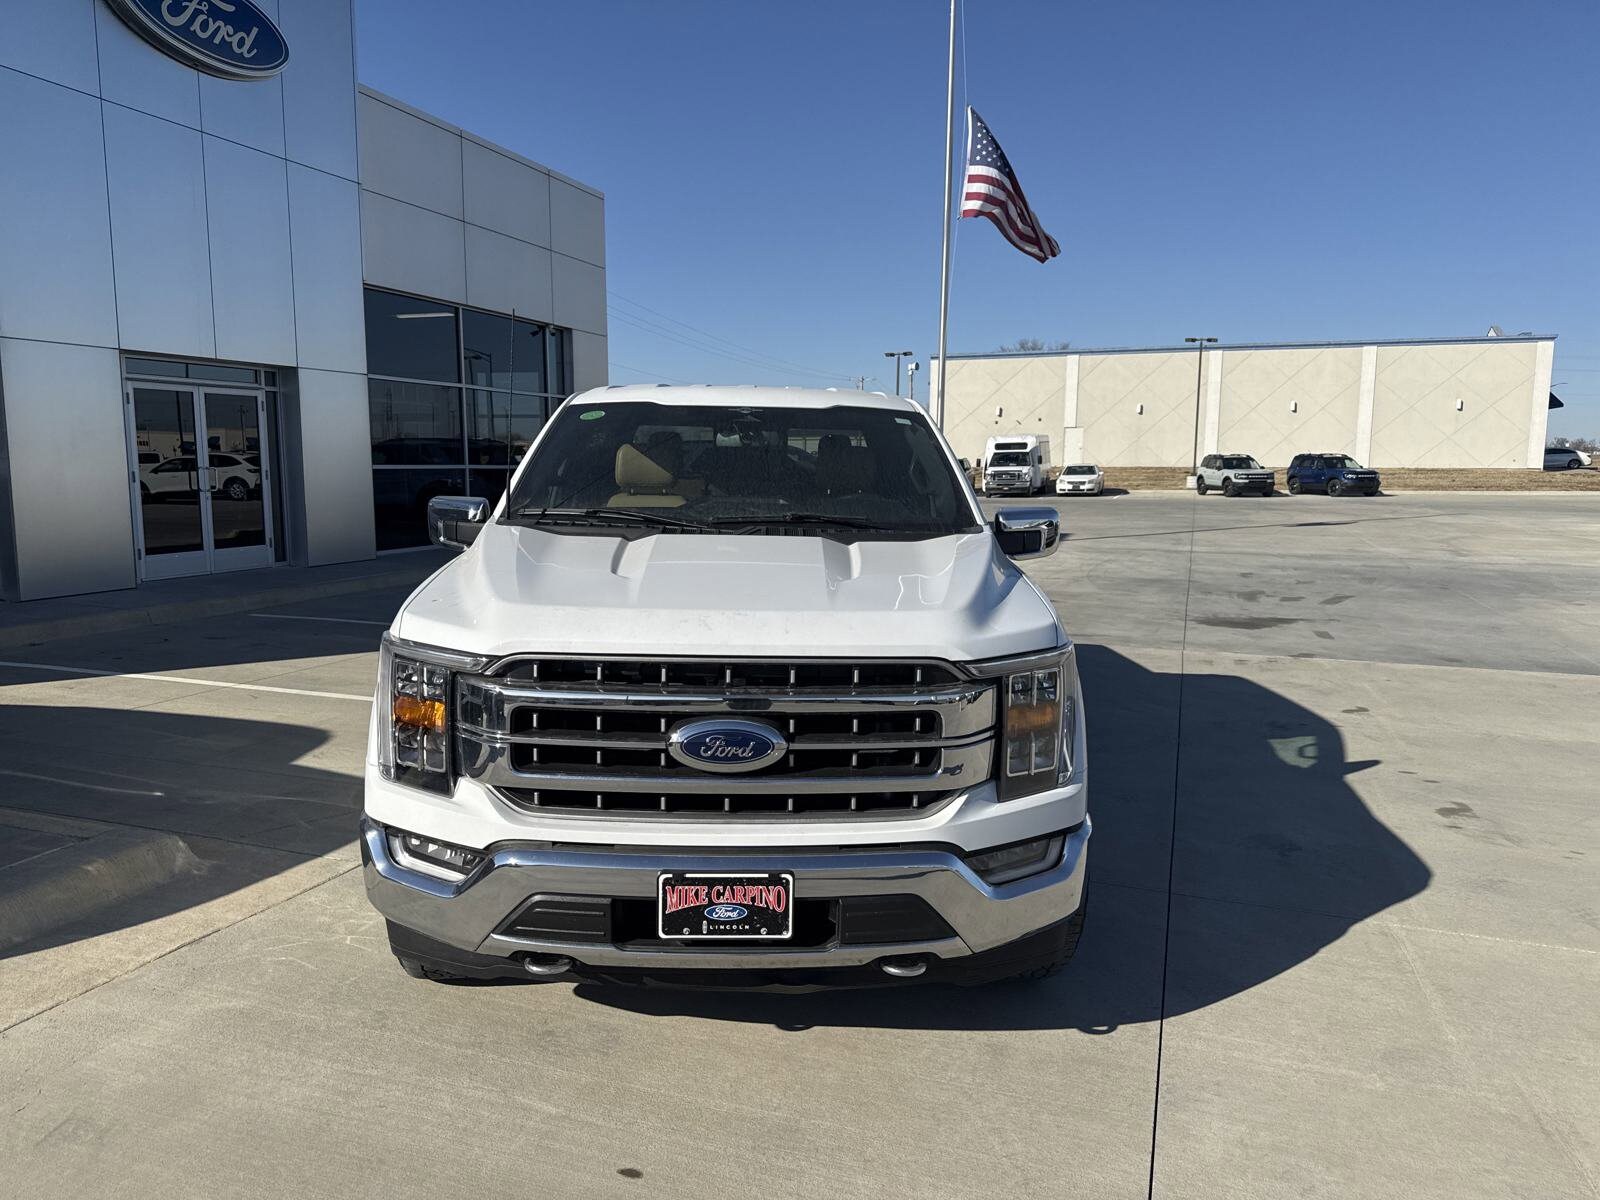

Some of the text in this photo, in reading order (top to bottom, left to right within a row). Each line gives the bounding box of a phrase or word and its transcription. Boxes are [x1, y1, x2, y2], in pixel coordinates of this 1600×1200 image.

[161, 0, 257, 58] Ford
[700, 735, 755, 757] Ford
[665, 885, 786, 914] MIKE CARPINO
[712, 906, 740, 918] Ford
